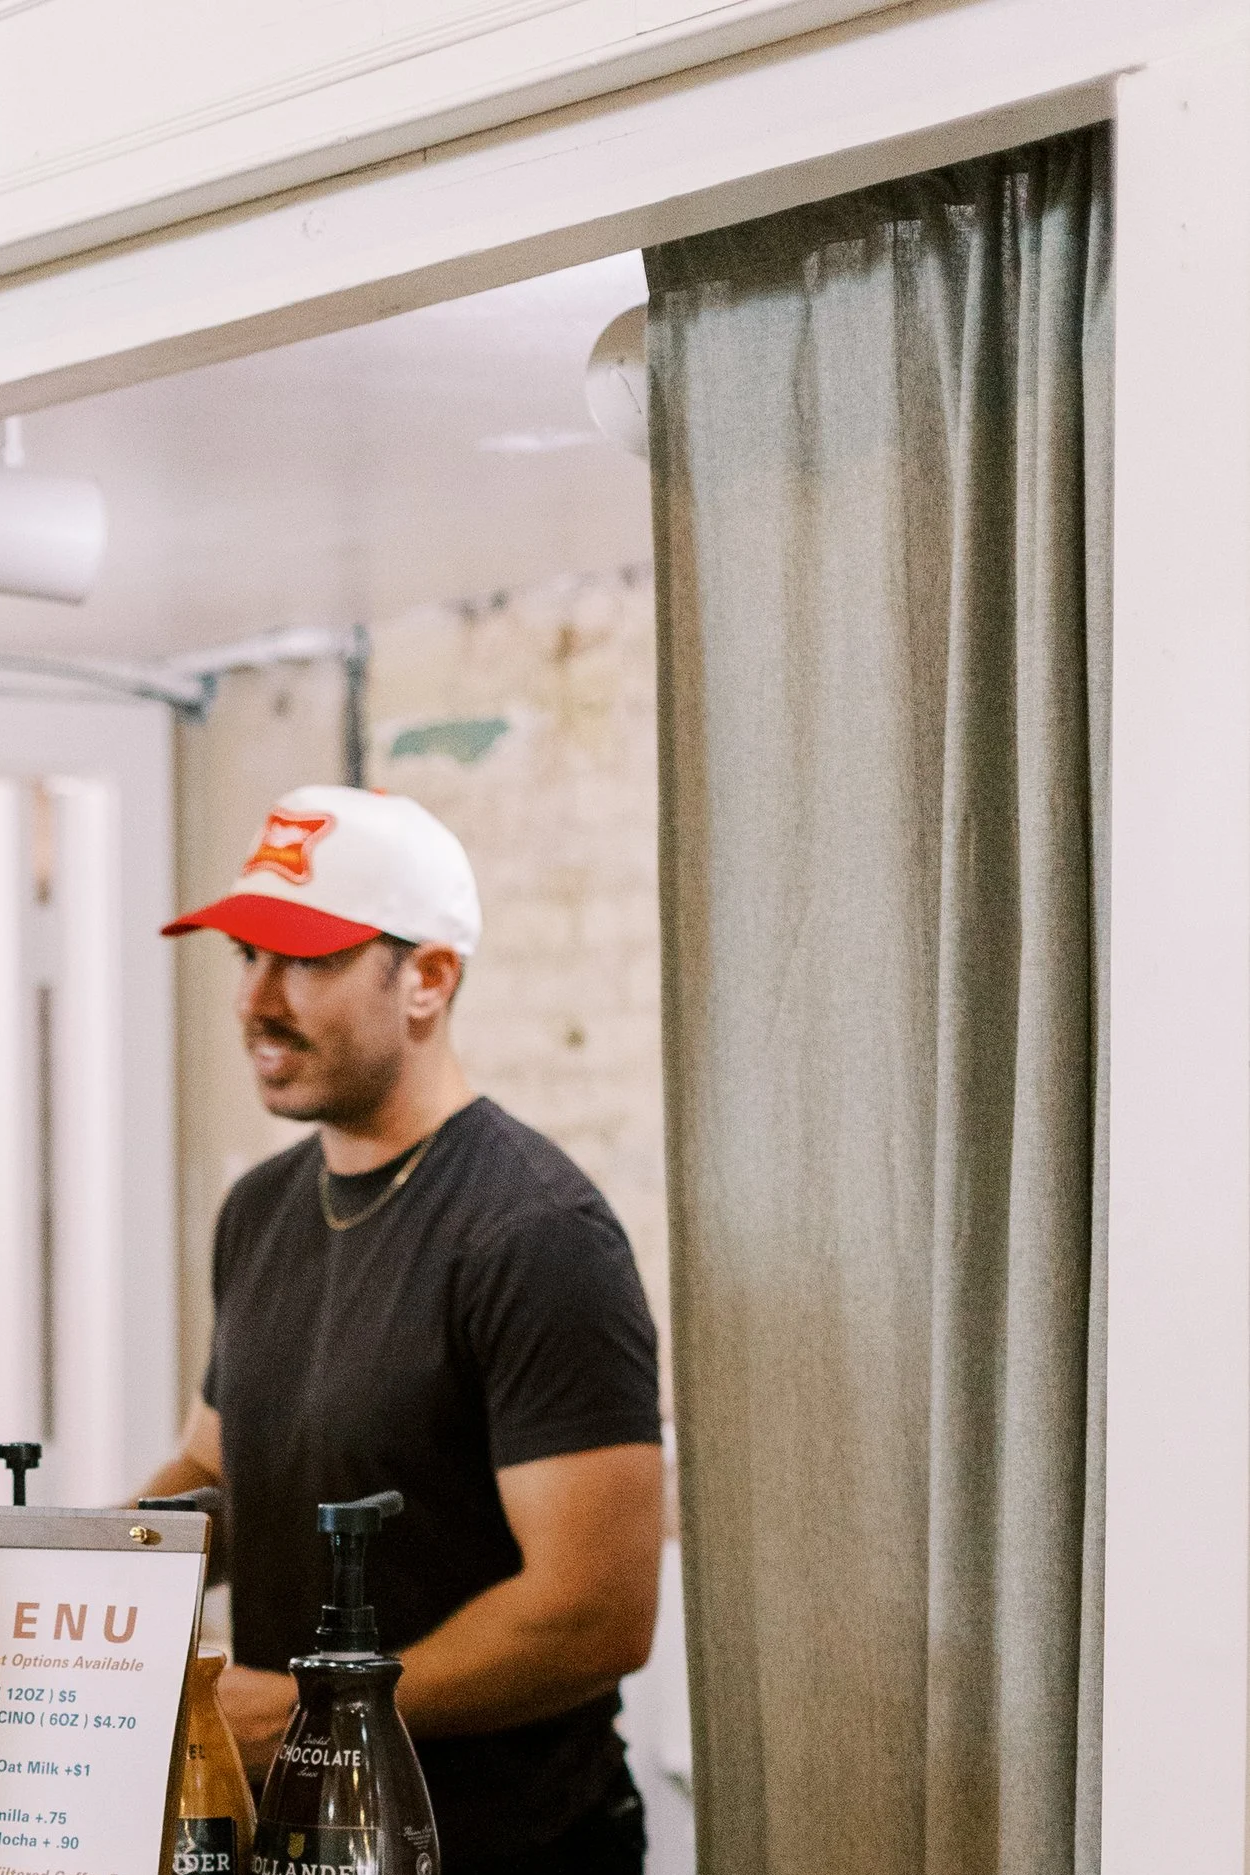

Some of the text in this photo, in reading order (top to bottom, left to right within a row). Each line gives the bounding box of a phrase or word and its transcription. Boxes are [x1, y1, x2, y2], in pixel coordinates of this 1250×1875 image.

[11, 1653, 69, 1670] Options
[72, 1655, 144, 1672] Available
[58, 1690, 77, 1703] $5
[93, 1714, 137, 1730] $4.70
[279, 1744, 362, 1768] CHOCOLATE
[27, 1761, 59, 1776] Milk
[64, 1764, 91, 1777] +$1
